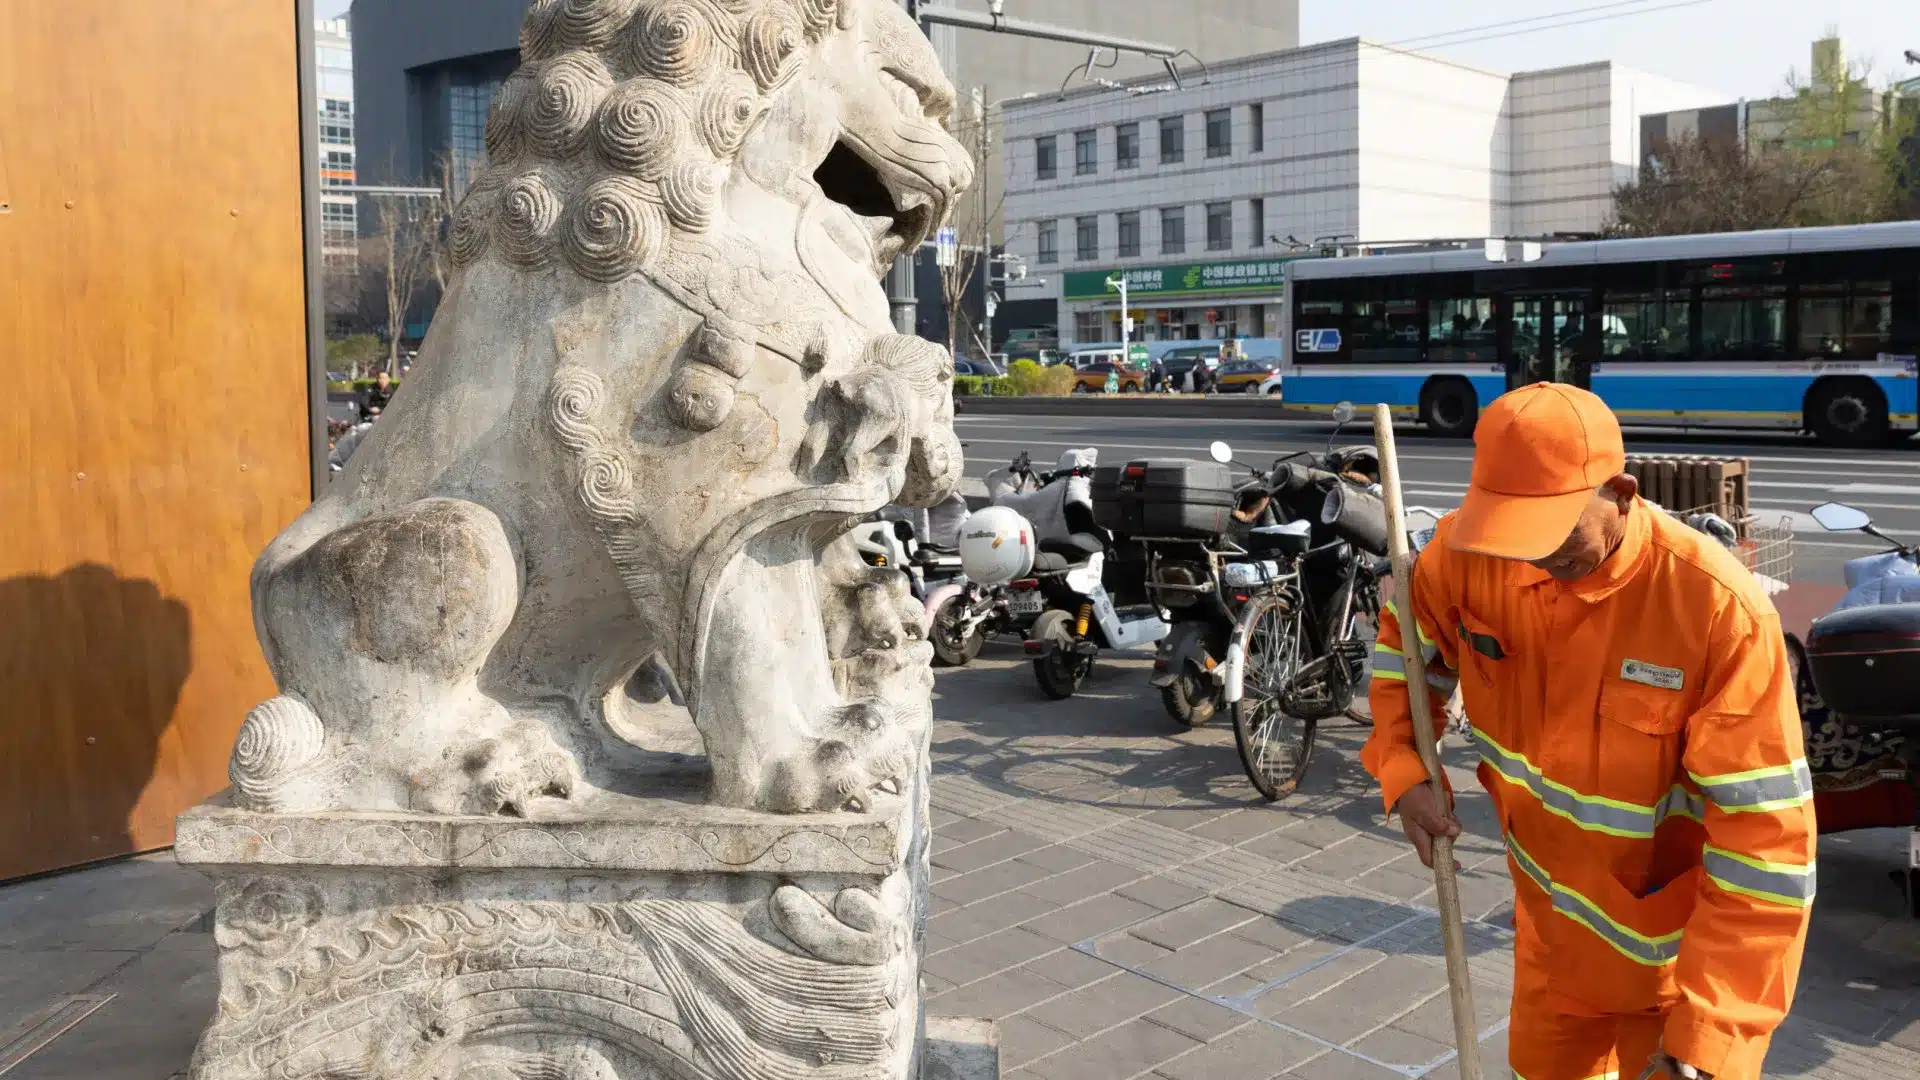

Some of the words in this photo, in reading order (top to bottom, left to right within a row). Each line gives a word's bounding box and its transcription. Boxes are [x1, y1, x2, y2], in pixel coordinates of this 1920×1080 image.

[1203, 263, 1285, 278] 中国邮政储蓄银
